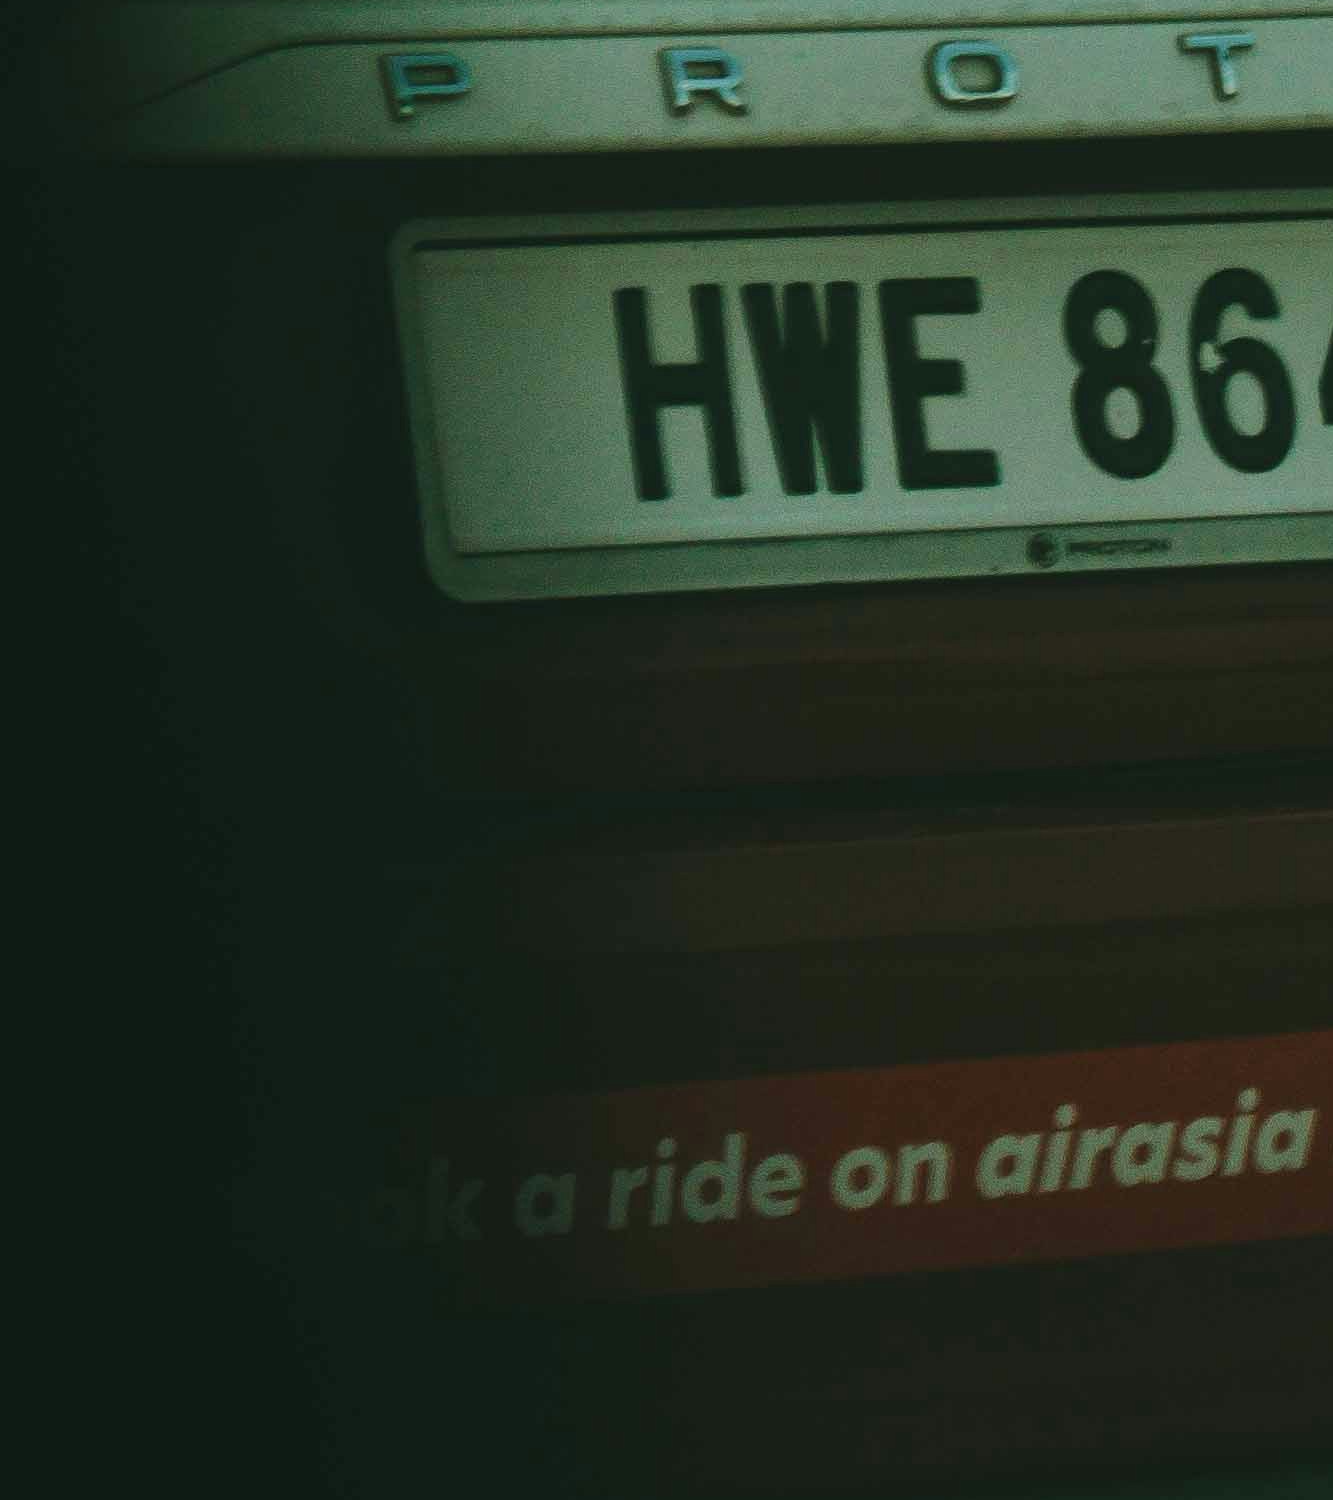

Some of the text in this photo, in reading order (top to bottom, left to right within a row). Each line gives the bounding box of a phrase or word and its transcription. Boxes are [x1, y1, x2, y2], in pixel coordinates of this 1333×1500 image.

[612, 275, 1002, 502] HWE
[513, 1172, 577, 1237] a
[606, 1131, 807, 1231] ride
[830, 1137, 953, 1211] on
[974, 1087, 1319, 1200] airasia
